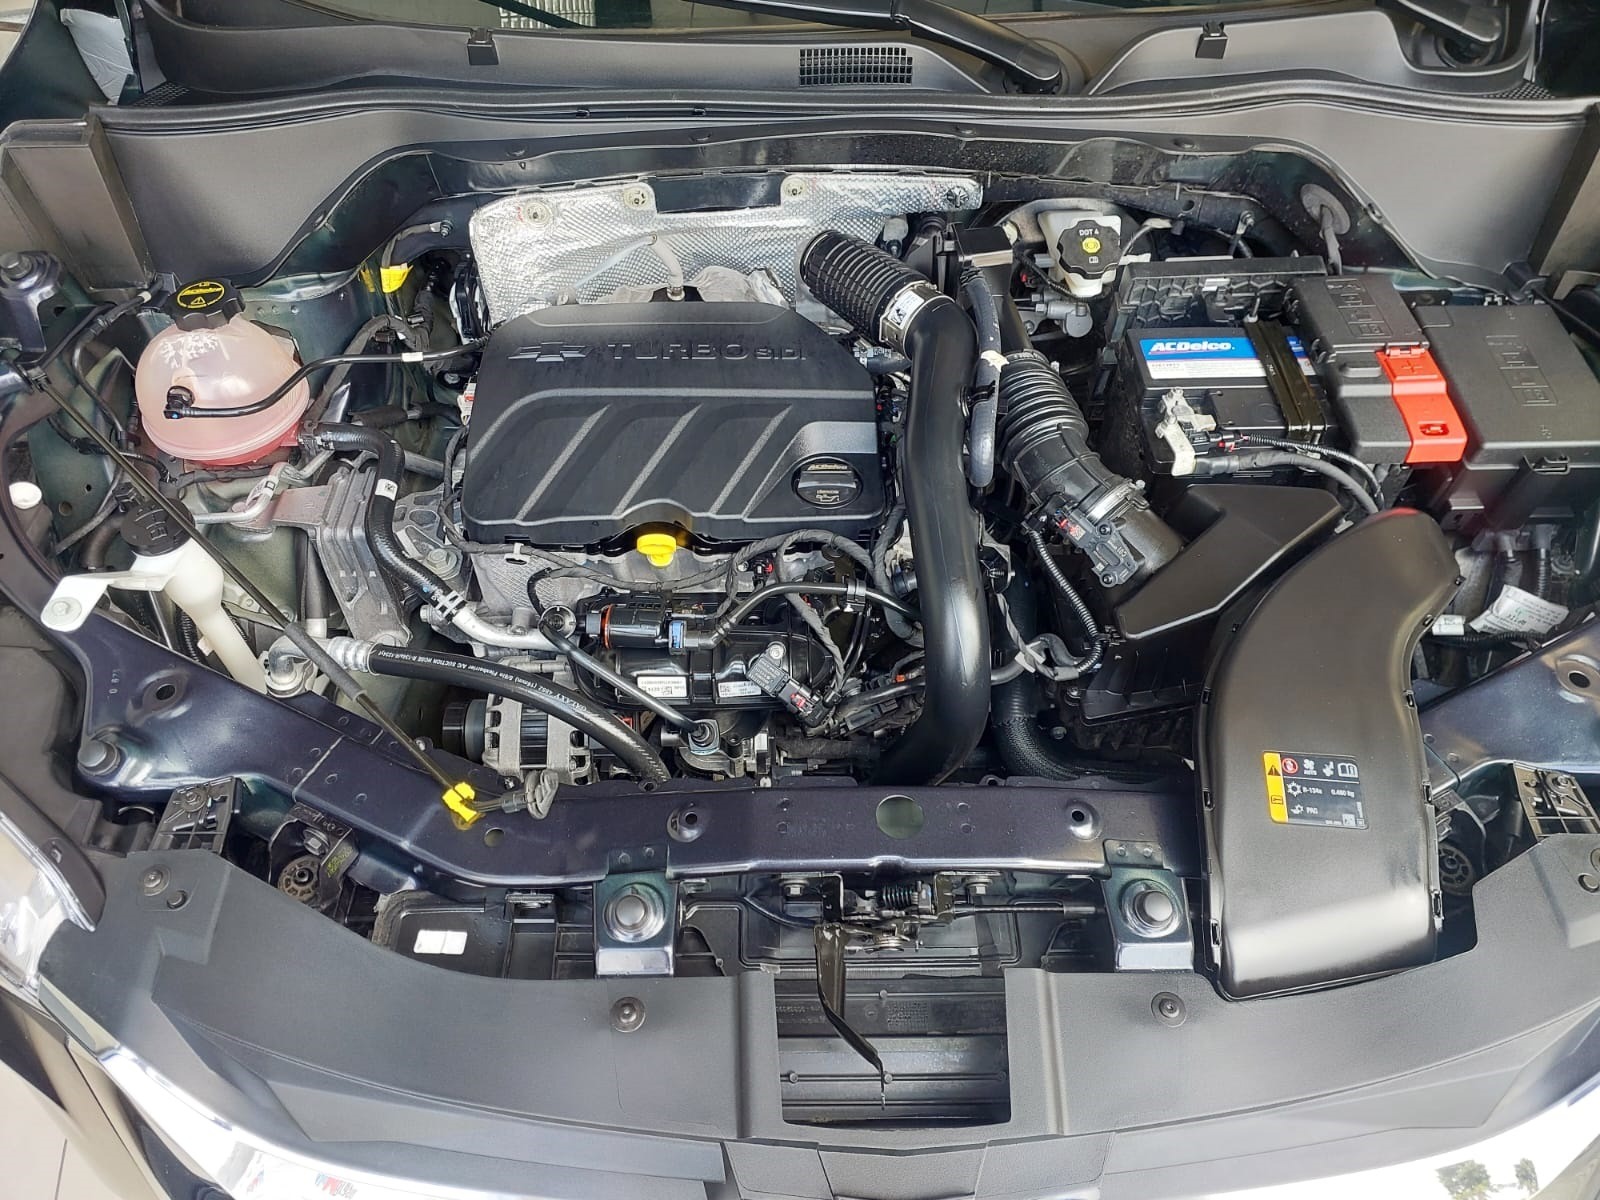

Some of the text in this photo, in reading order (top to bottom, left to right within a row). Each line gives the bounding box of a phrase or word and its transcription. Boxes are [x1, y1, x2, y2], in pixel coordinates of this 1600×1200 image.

[607, 344, 749, 360] TURBO
[1150, 341, 1232, 351] ACDelco
[432, 658, 457, 667] SUCTION
[554, 693, 587, 712] GALAXY
